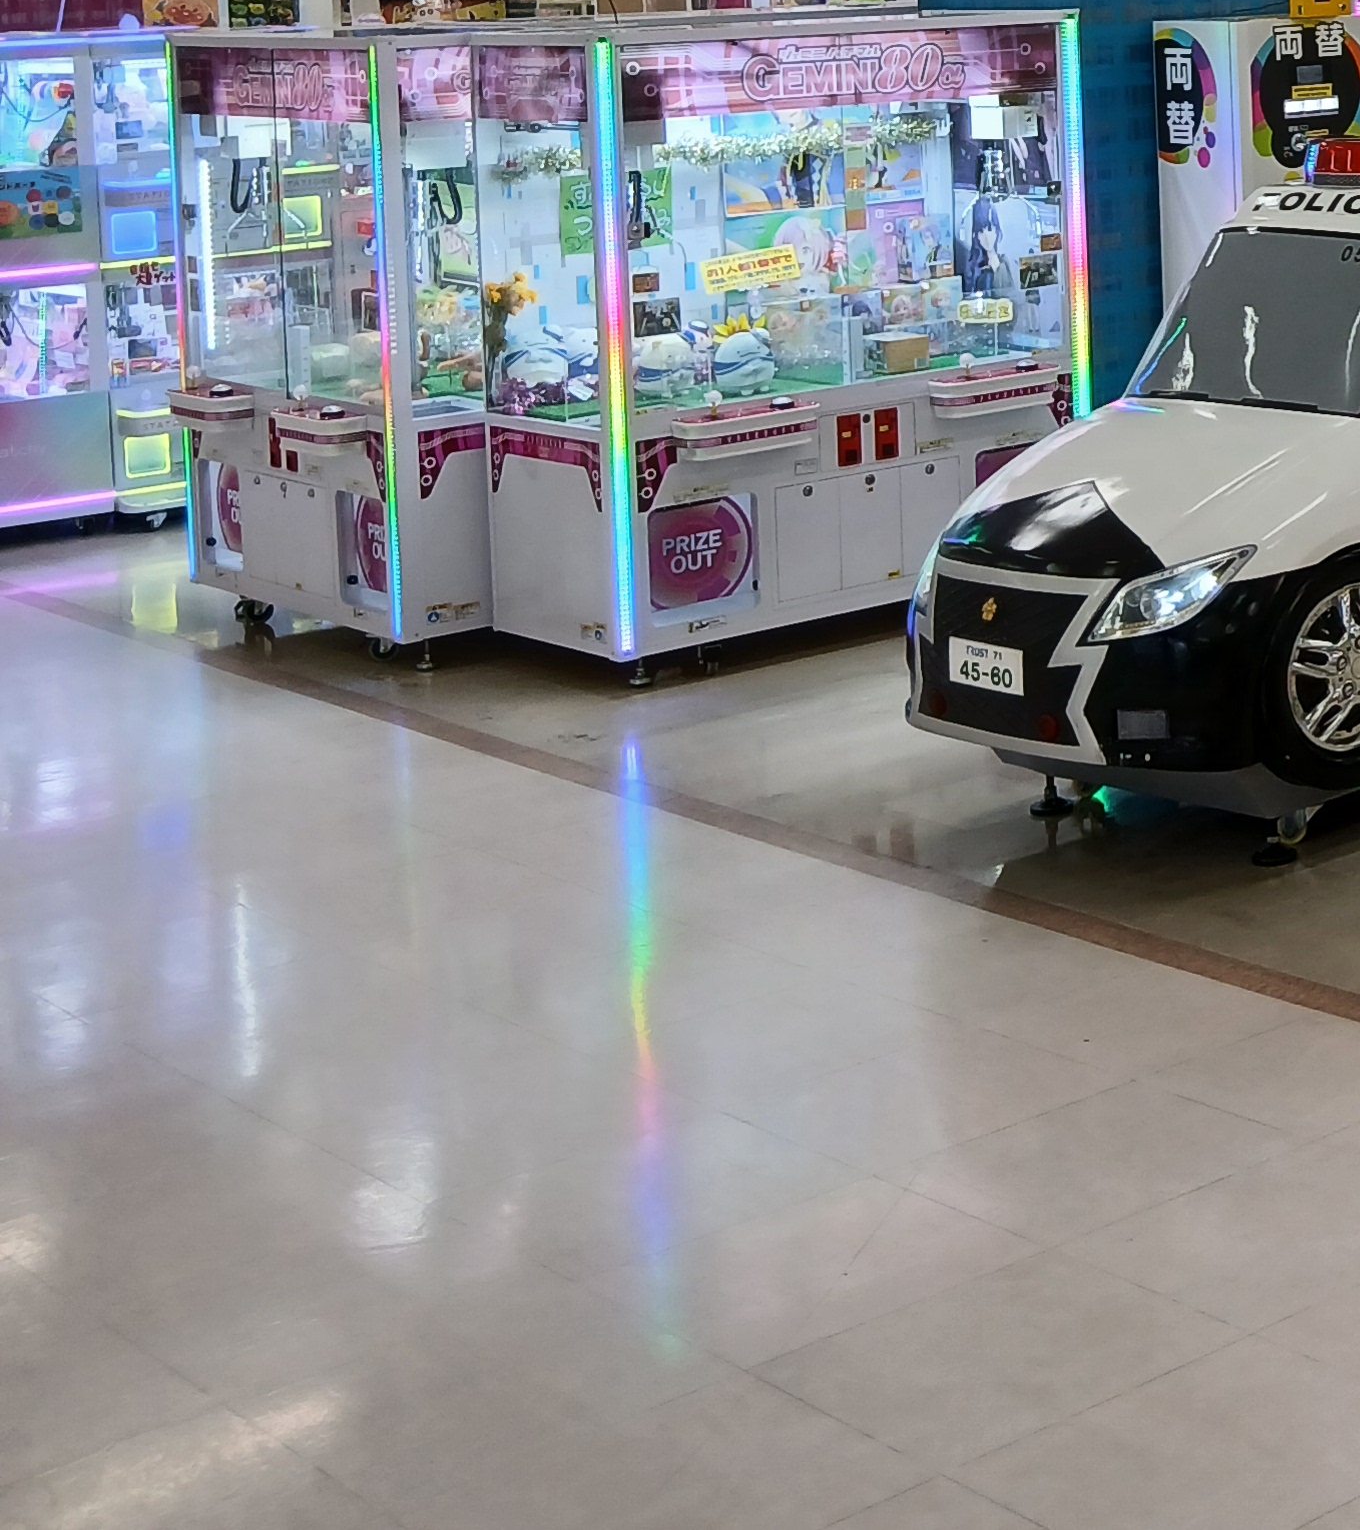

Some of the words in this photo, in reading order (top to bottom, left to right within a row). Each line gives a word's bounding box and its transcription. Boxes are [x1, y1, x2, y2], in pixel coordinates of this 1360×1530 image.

[1273, 22, 1345, 61] 両替
[1163, 47, 1195, 145] 両替
[661, 528, 723, 556] PRIZE
[670, 549, 718, 575] OUT
